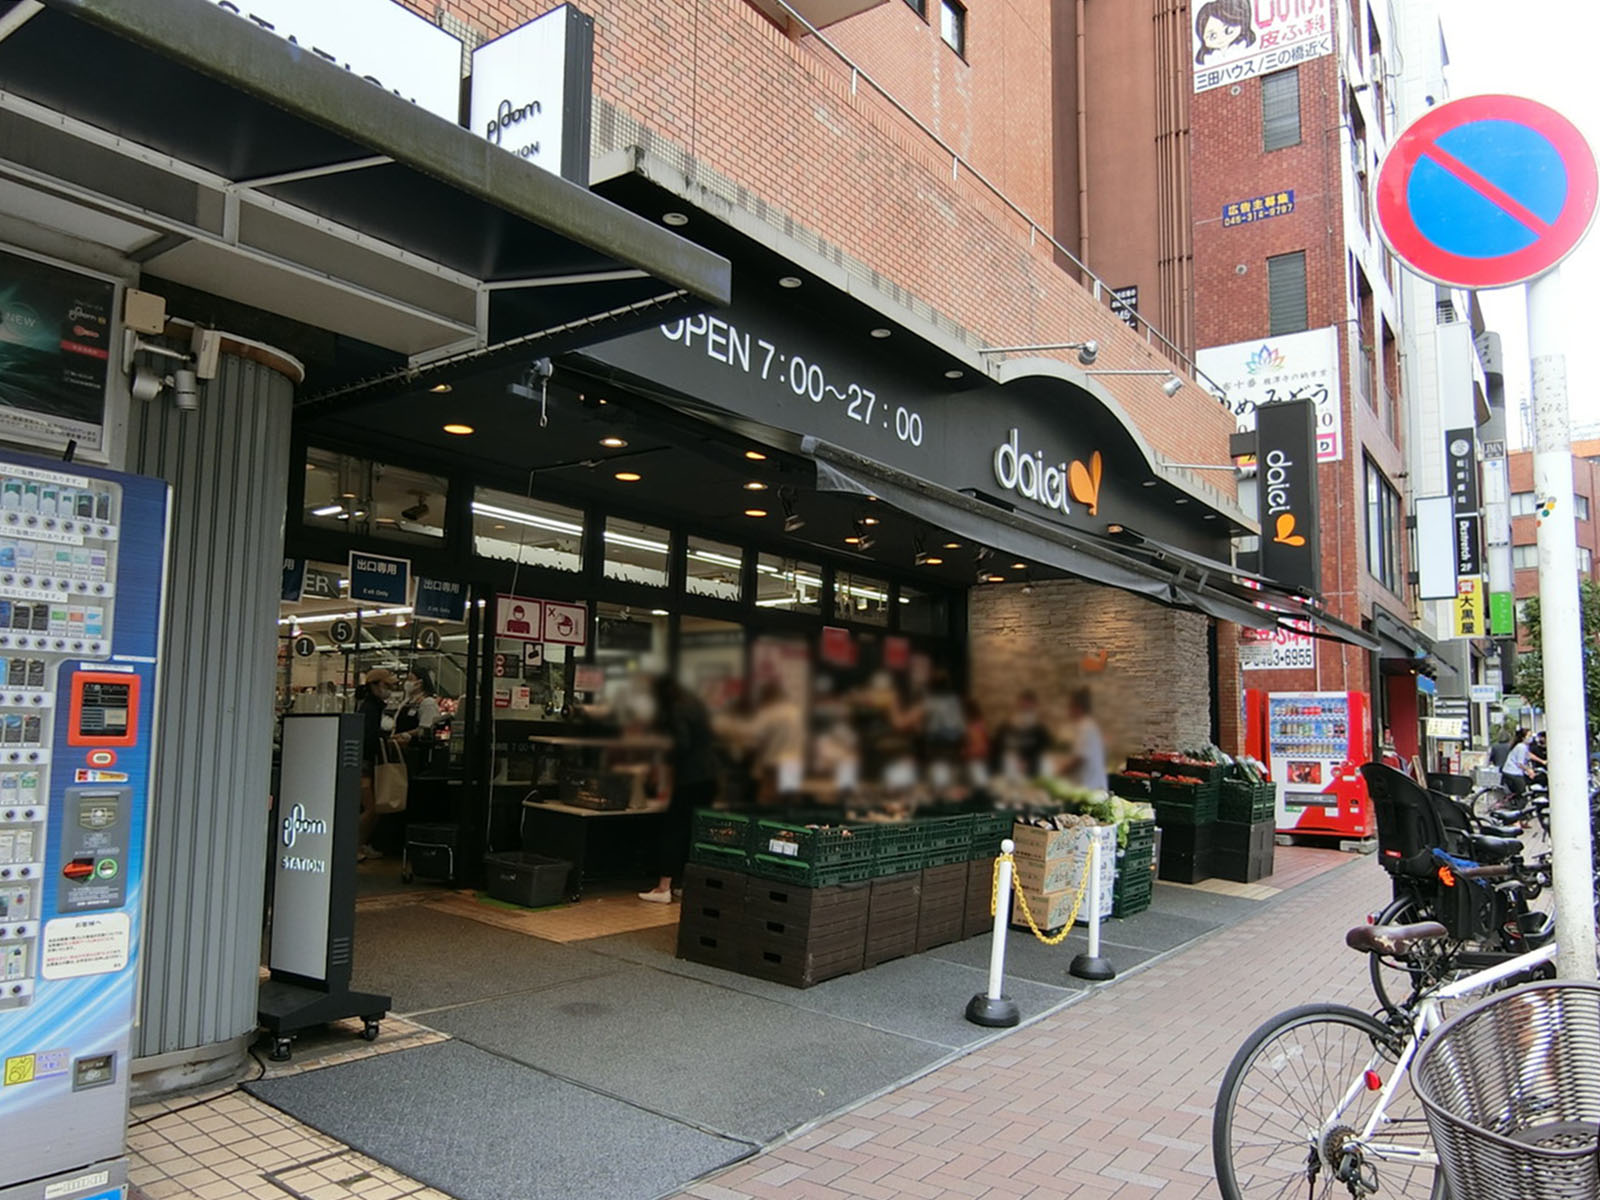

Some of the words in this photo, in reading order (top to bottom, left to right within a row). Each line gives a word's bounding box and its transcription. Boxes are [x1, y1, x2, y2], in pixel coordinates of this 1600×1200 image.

[1260, 15, 1325, 49] 皮ふ科
[356, 558, 398, 576] 出口専用
[423, 579, 460, 594] 出口専用
[1460, 596, 1474, 633] 大黒屋
[337, 622, 346, 640] 5
[425, 635, 435, 648] 4
[282, 856, 325, 873] STATION
